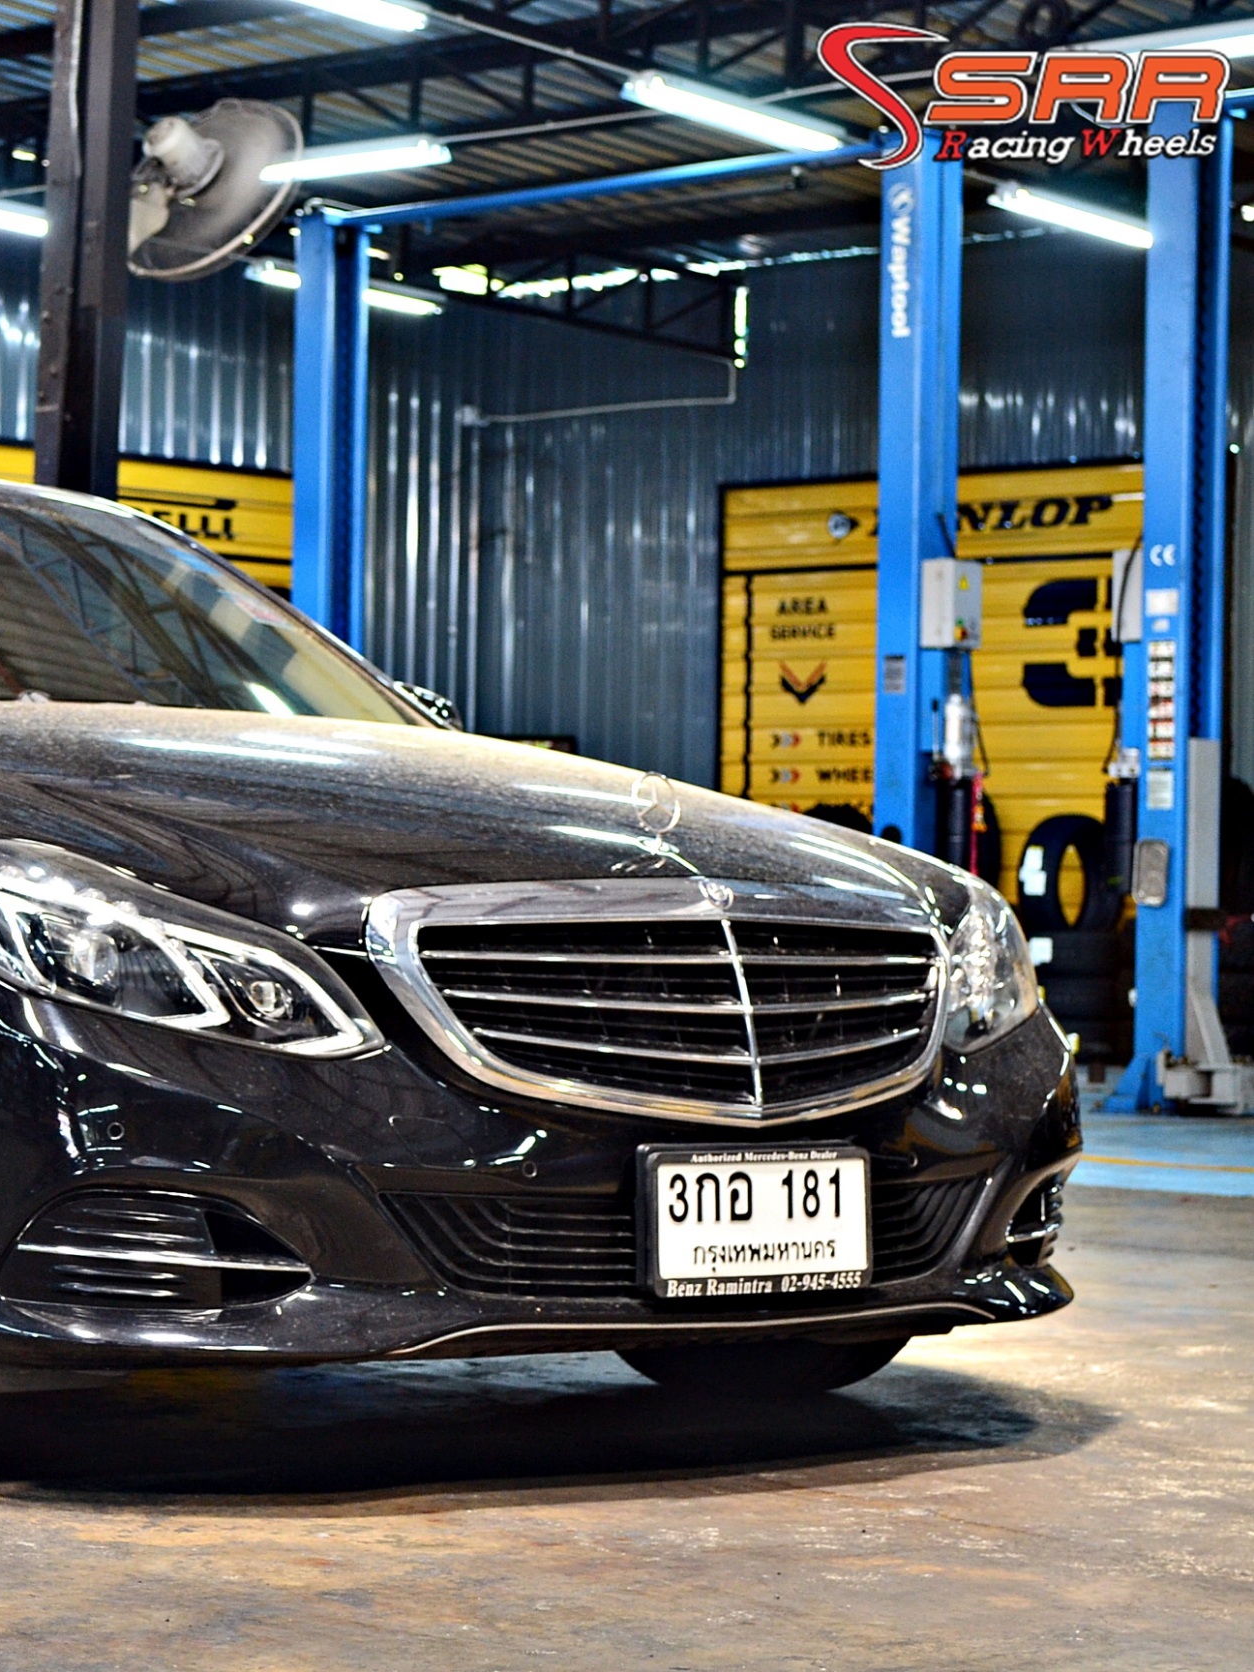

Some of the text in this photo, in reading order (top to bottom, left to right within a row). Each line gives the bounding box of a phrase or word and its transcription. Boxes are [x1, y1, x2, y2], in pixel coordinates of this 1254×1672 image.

[868, 495, 1114, 536] NLOP
[777, 596, 829, 615] AREA
[770, 623, 836, 640] SERVICE
[817, 730, 872, 746] TIRES
[816, 767, 874, 783] WHEE
[690, 1150, 838, 1163] Authorized Mercedes-Benz Dealer
[669, 1167, 841, 1222] 3กอ 181
[693, 1239, 836, 1273] กรุงเทพมหานคร
[666, 1272, 862, 1298] Benz Ramintra 02-945-4555
